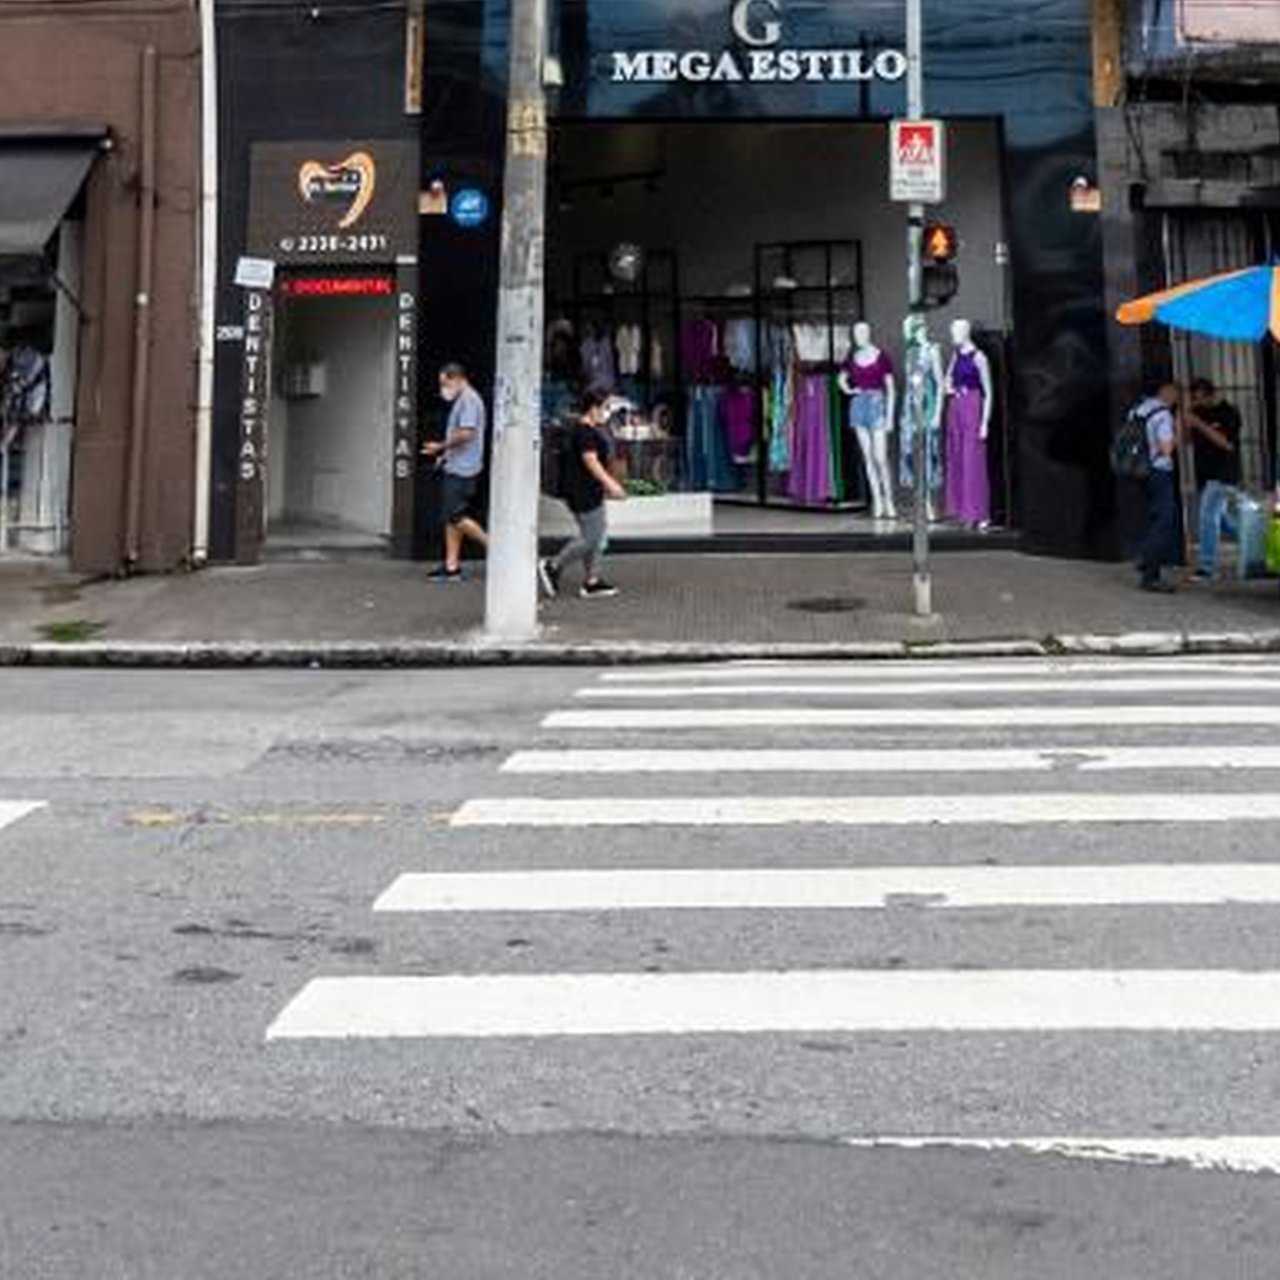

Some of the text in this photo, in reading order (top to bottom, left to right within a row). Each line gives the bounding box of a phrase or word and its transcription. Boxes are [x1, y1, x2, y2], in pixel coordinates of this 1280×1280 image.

[611, 50, 907, 81] MEGA ESTILO
[240, 293, 262, 480] DENTISTAS
